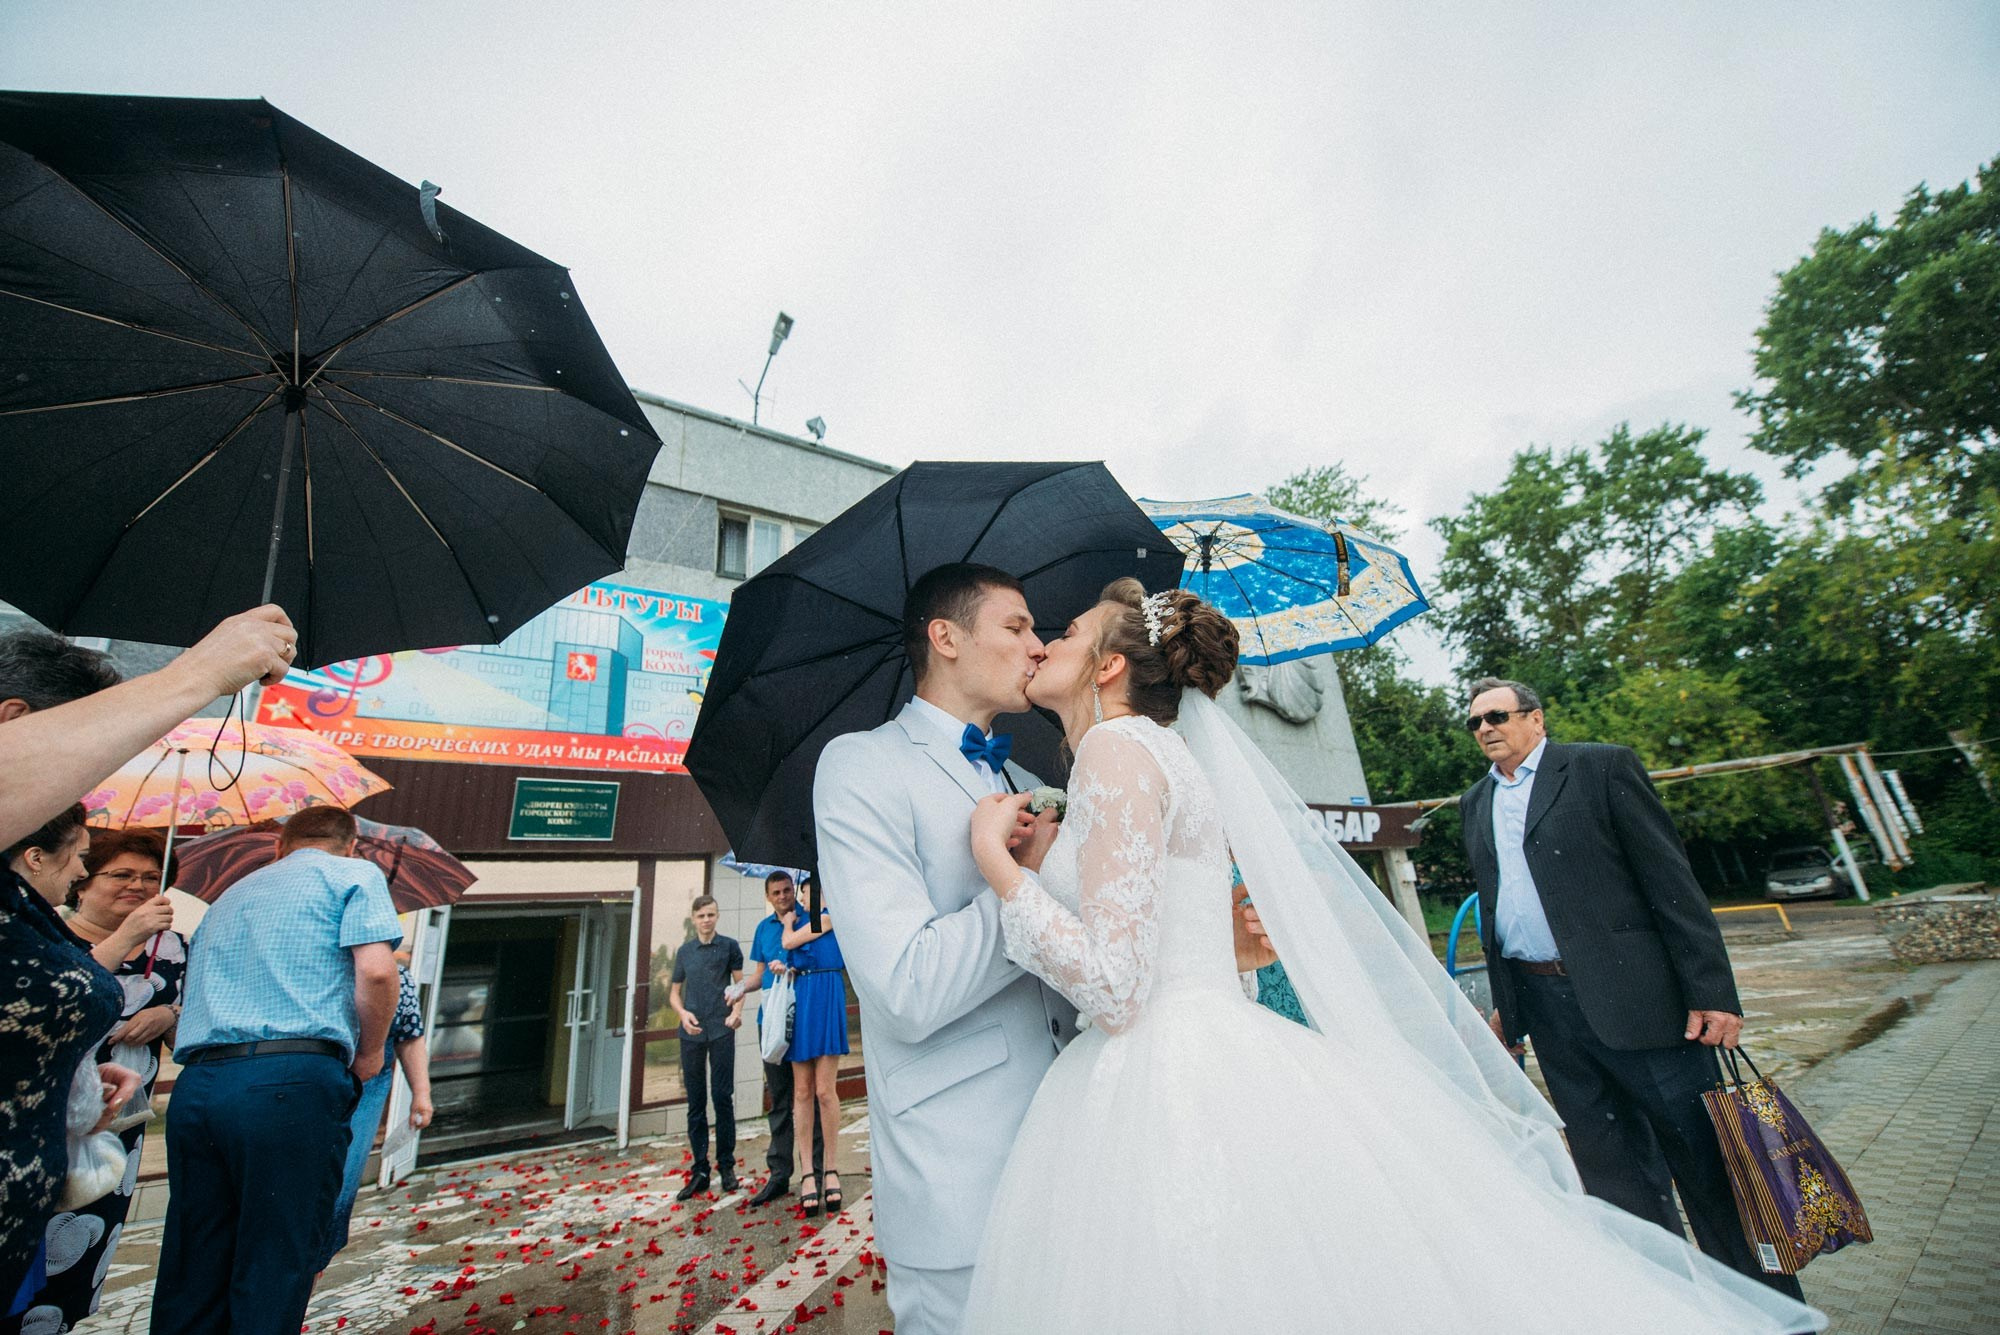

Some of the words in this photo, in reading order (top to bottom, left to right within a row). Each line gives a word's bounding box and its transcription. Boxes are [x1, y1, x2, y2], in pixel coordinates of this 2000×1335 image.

[645, 648, 683, 660] город
[645, 660, 701, 675] КОХМА
[373, 733, 511, 756] ТВОРЧЕСКИХ
[516, 742, 565, 759] УДАЧ
[568, 745, 601, 761] МЫ
[605, 748, 684, 765] РАСПАХН
